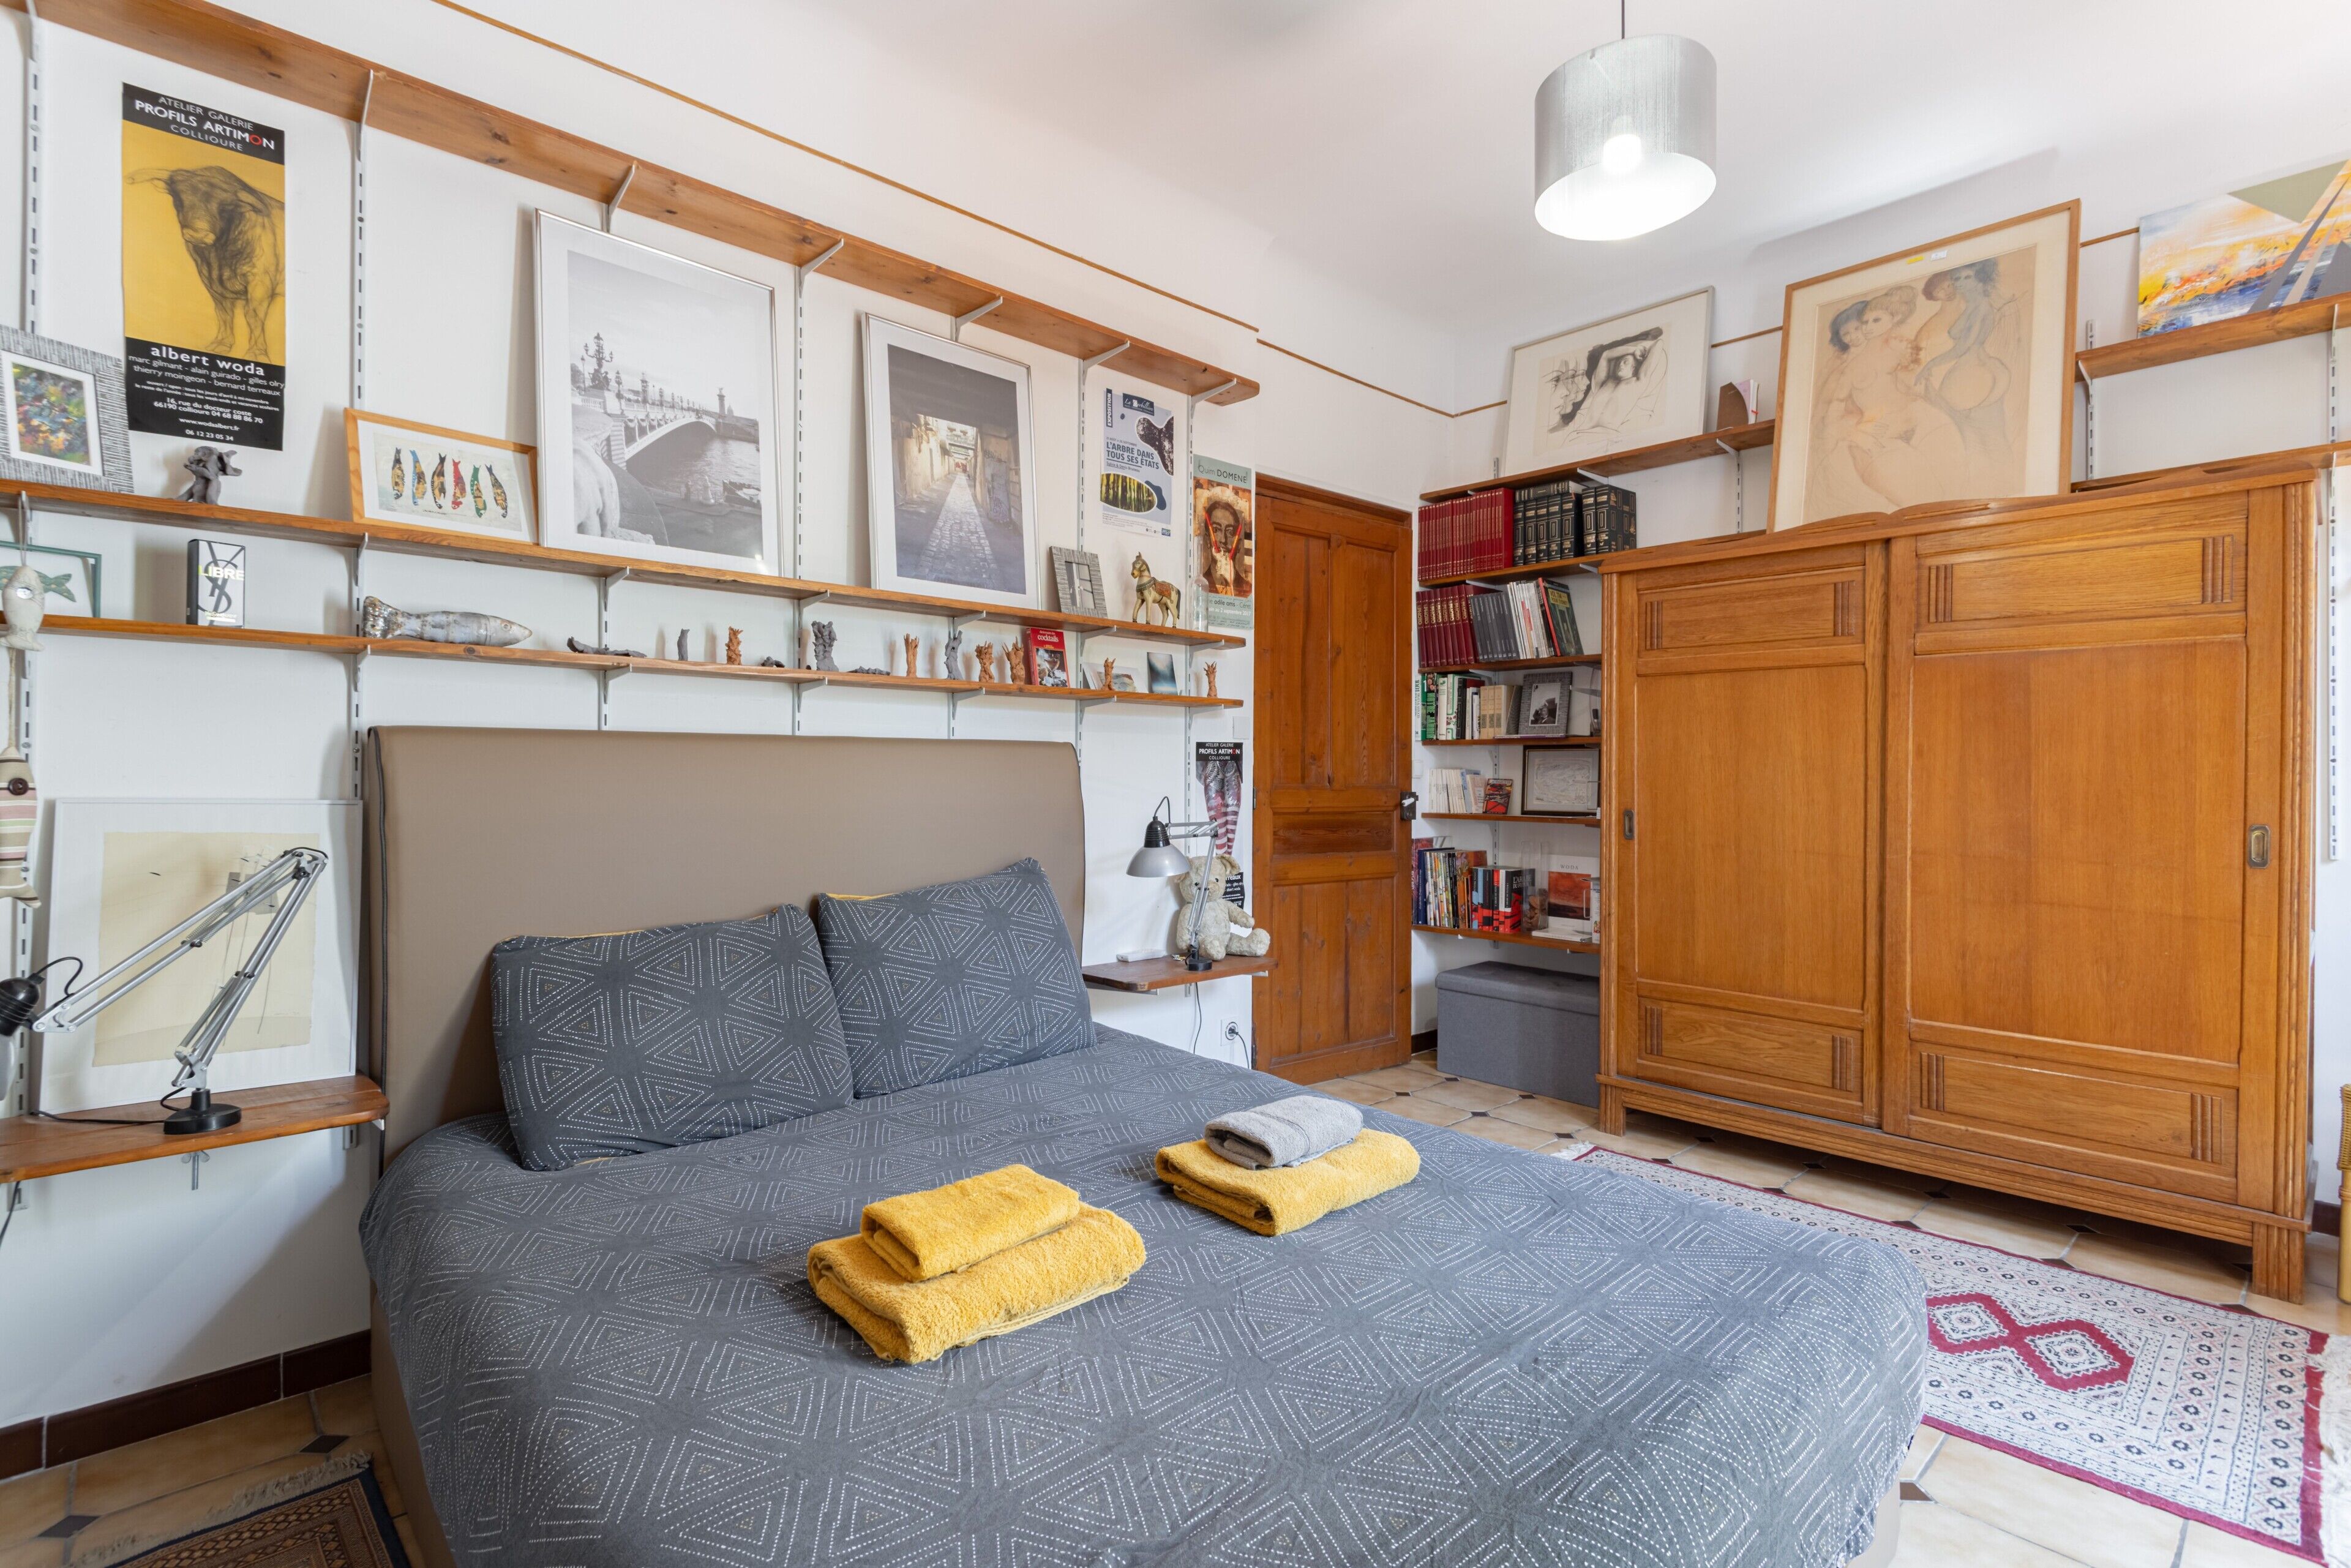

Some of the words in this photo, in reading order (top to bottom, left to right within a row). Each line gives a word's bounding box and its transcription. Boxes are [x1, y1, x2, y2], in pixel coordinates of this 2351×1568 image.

[158, 96, 204, 116] ATELIER
[208, 110, 254, 132] GALERIE
[134, 99, 198, 127] PROFILS
[203, 120, 275, 151] ARTIMON
[170, 124, 244, 152] COLLIOURE
[150, 345, 210, 366] albert
[216, 359, 265, 376] woda
[128, 355, 151, 364] marc
[152, 359, 184, 370] gilmant
[190, 366, 209, 375] alain
[211, 370, 241, 381] guirado
[249, 377, 268, 386] gilles
[269, 380, 285, 389] olry
[133, 366, 163, 377] thierry
[164, 371, 206, 384] moingeon
[214, 379, 246, 391] bernard
[247, 386, 282, 397] terreaux
[153, 401, 178, 410] 66190
[178, 405, 211, 416] collioure
[203, 403, 231, 413] docteur
[178, 417, 241, 432] www.wodaalbert.fr
[1106, 441, 1135, 455] L'ARBRE
[1136, 448, 1154, 460] DANS
[1106, 449, 1125, 461] TOUS
[1127, 454, 1139, 464] SES
[1198, 465, 1216, 475] Quim
[198, 565, 245, 581] LIBRE
